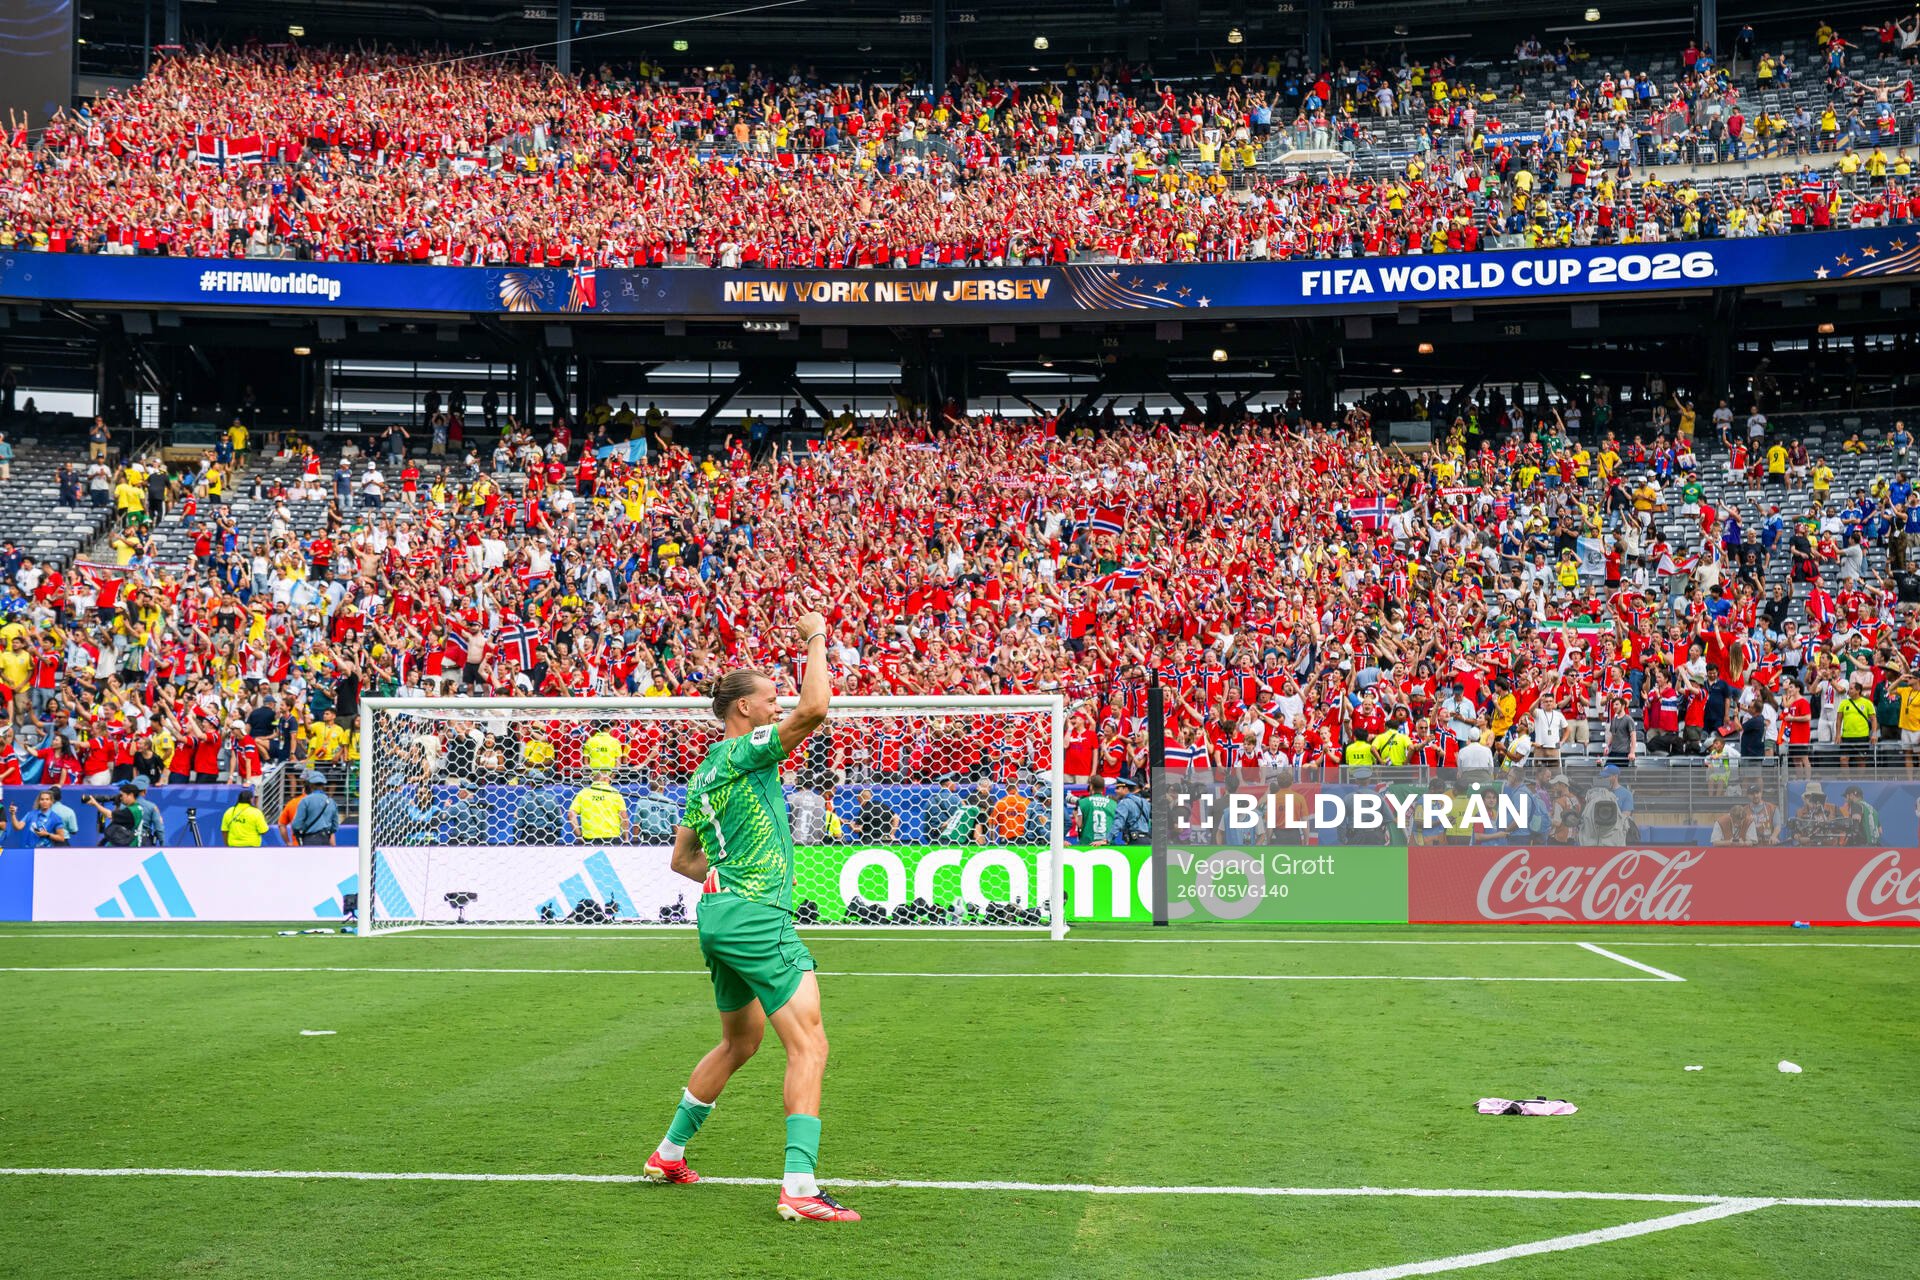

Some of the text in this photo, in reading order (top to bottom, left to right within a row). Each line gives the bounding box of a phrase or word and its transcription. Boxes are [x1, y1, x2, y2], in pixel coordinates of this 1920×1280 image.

[200, 271, 341, 302] #FIFAWorldCup
[724, 278, 1051, 303] NEW YORK NEW JERSEY
[1302, 251, 1715, 297] FIFA WORLD CUP 2026
[839, 848, 1266, 920] aramco
